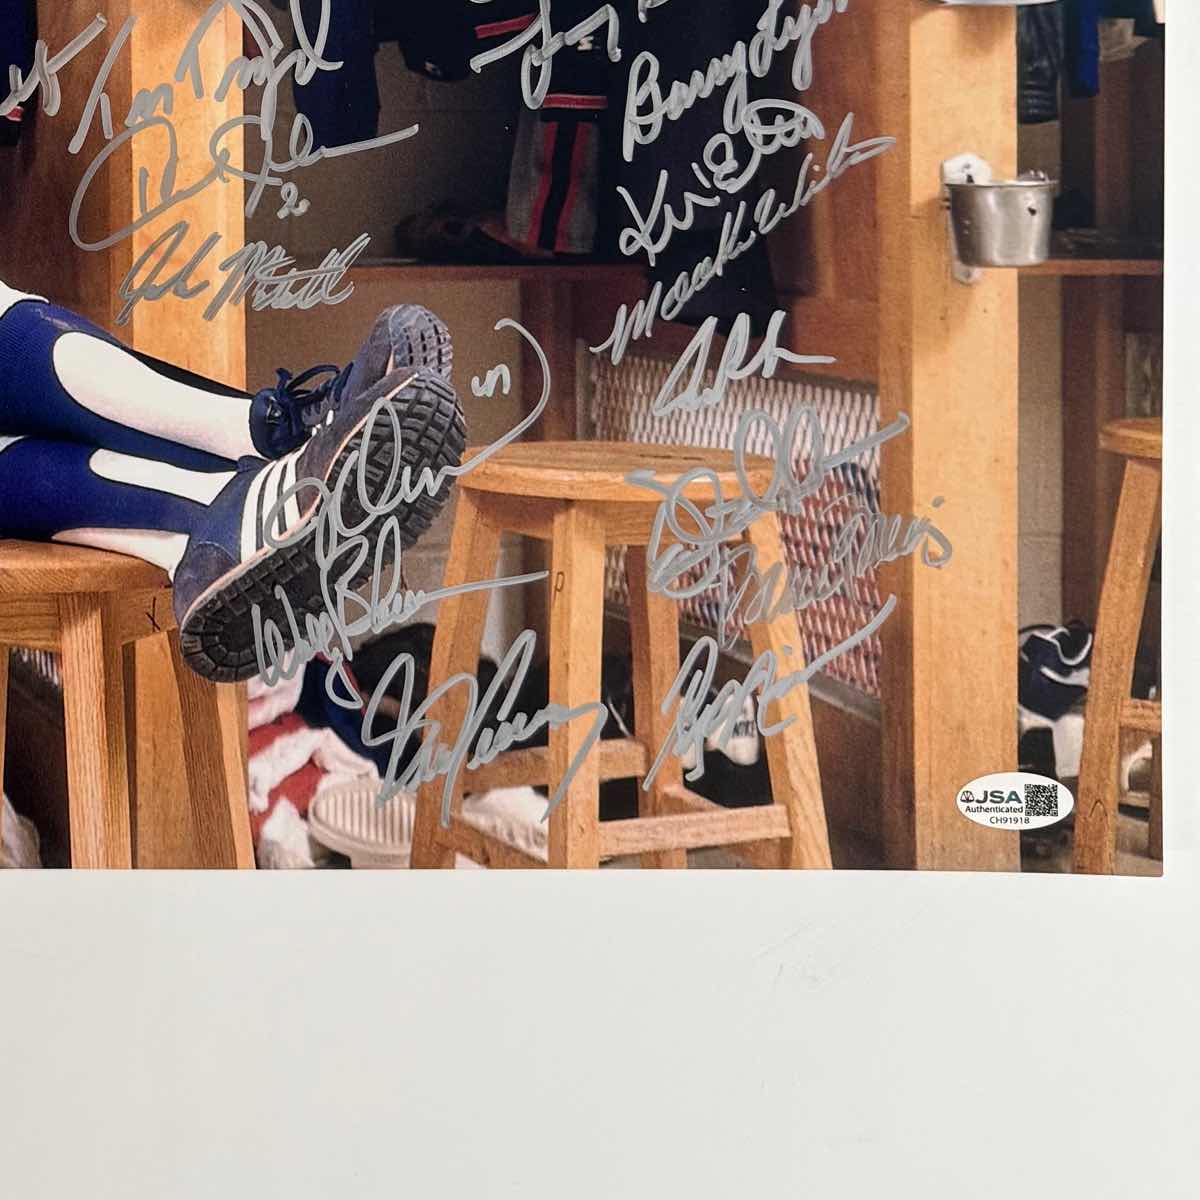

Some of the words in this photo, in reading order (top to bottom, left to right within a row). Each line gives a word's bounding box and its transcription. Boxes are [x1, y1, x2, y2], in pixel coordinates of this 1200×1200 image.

[975, 790, 1022, 804] JSA
[965, 805, 1023, 814] Authenticated
[989, 816, 1030, 825] CH91918
